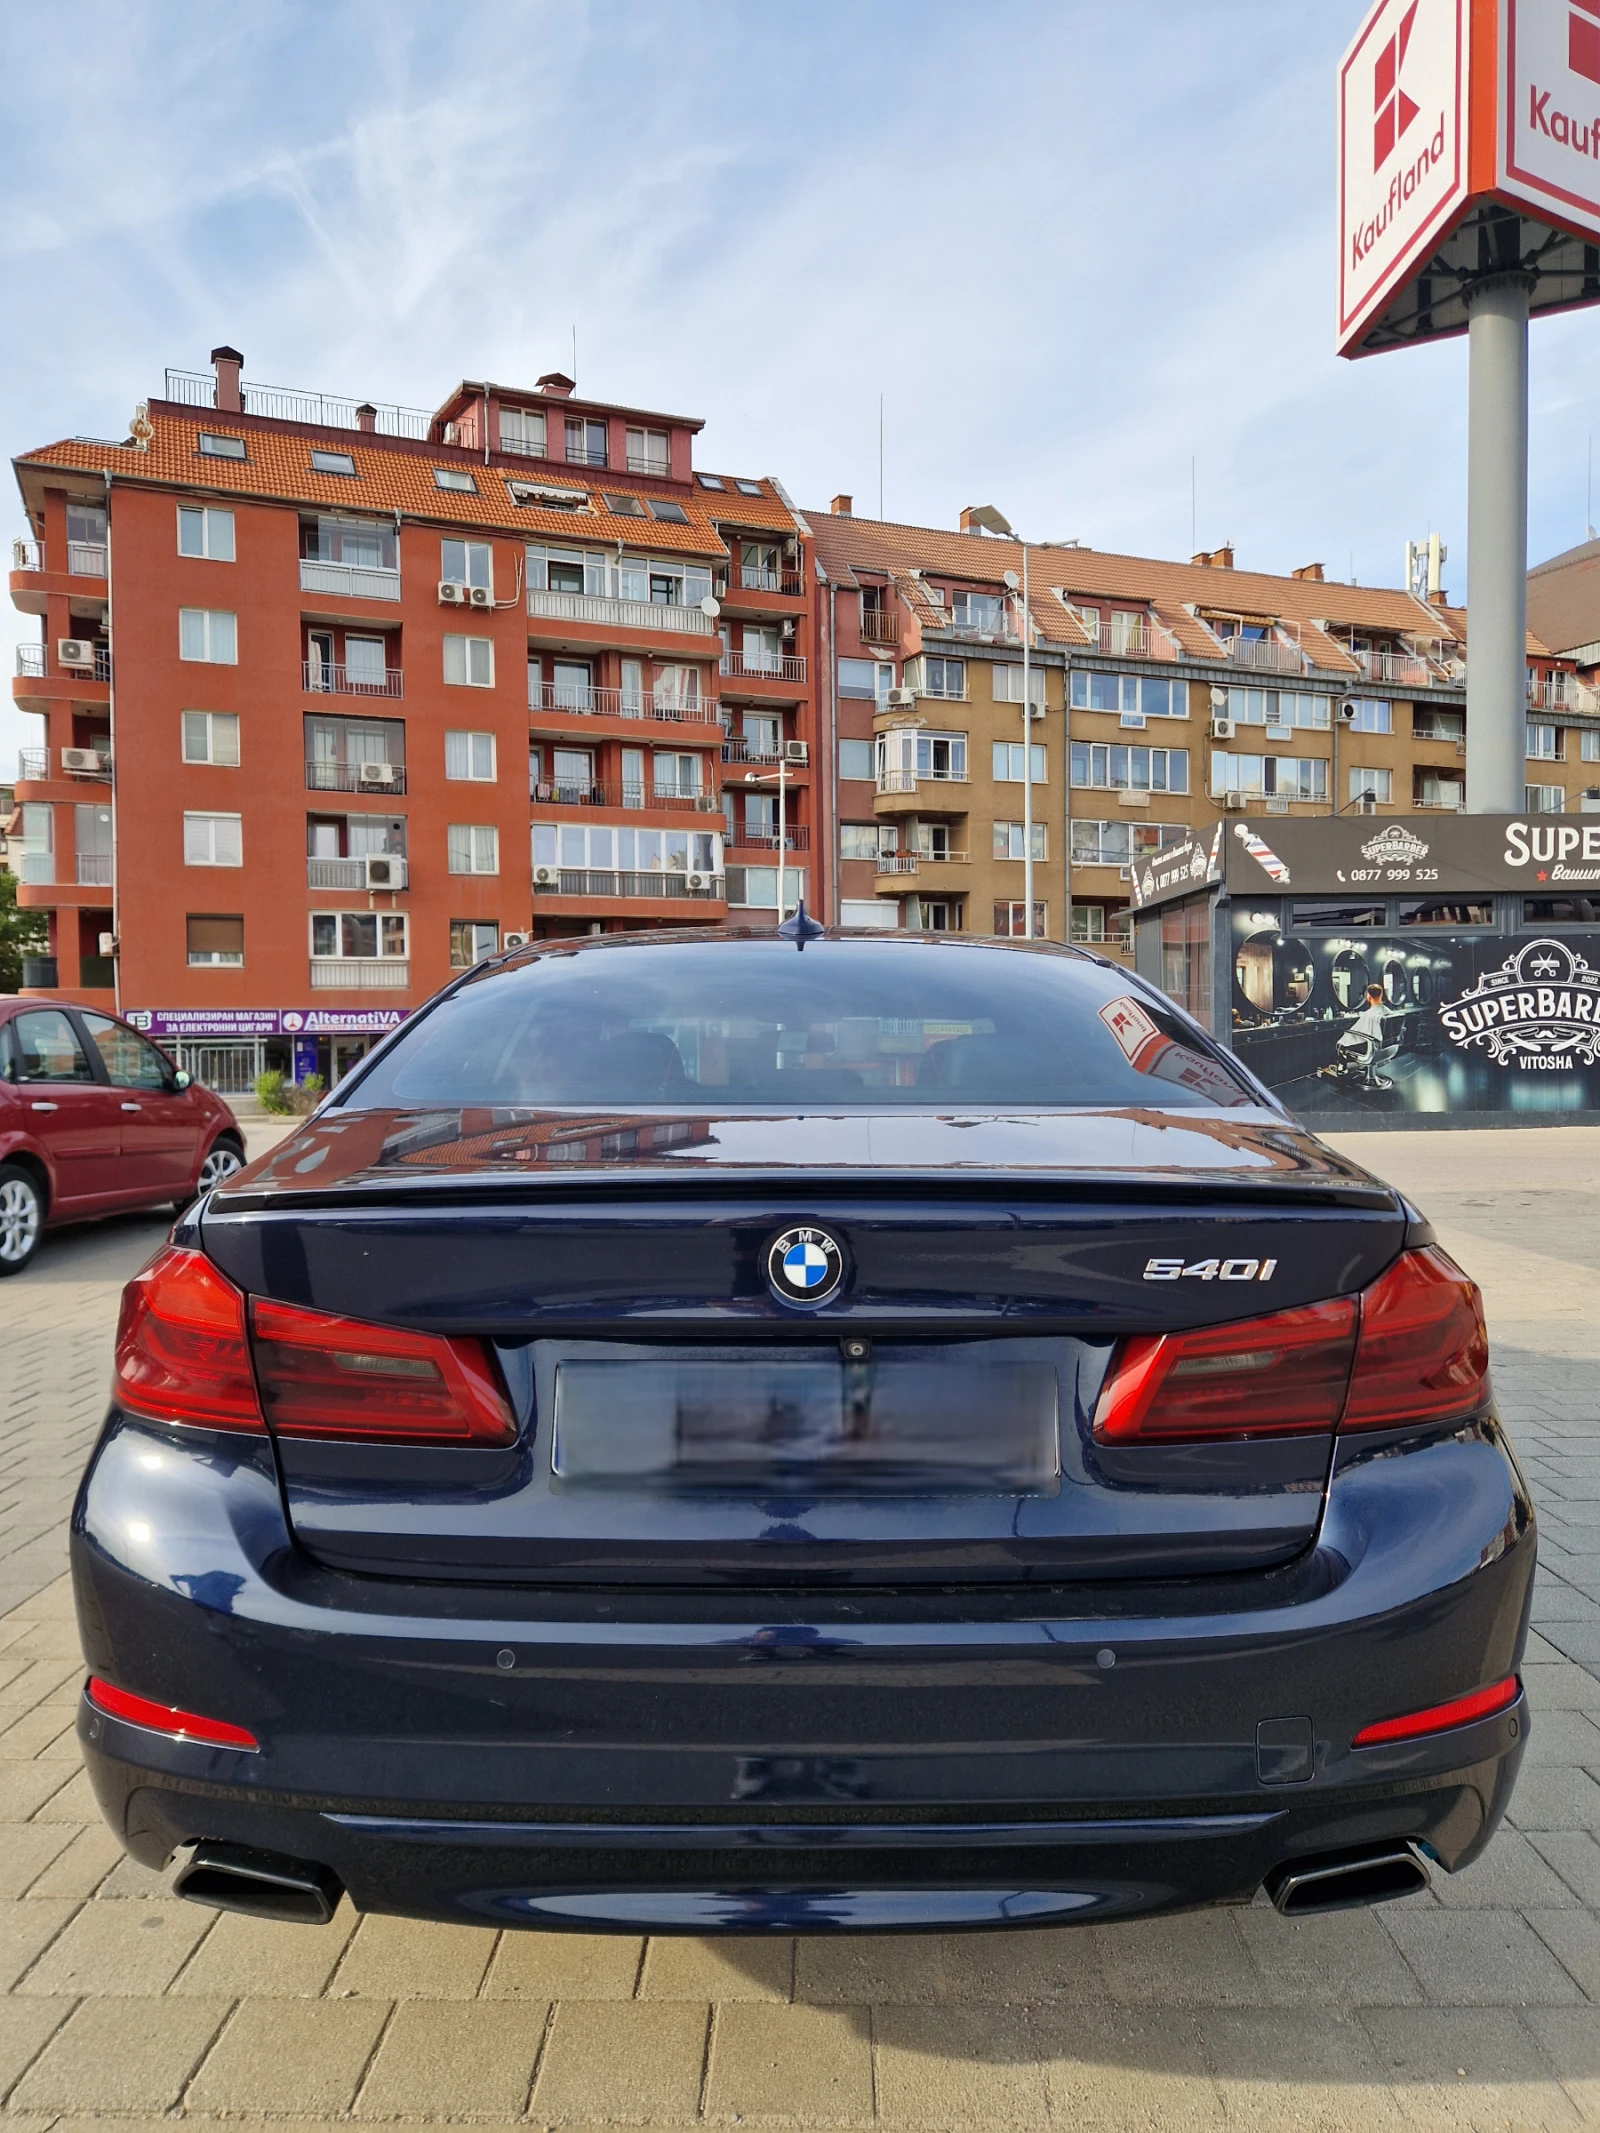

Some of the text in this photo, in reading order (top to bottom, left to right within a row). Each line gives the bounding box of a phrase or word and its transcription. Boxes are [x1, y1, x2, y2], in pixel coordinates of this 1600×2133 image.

[1352, 109, 1445, 272] Kaufland
[1350, 868, 1438, 881] 0877 999 525
[1490, 976, 1510, 986] SINCE
[1581, 975, 1598, 984] 2022
[157, 1012, 276, 1022] СПЕЦИАЛИЗИРАН МАГАЗИН
[304, 1011, 400, 1029] AlternatiVA
[166, 1023, 273, 1032] ЗА ЕЛЕКТРОННИ ЦИГАРИ
[1519, 1055, 1573, 1070] VITOSHA
[776, 1230, 836, 1254] BMW
